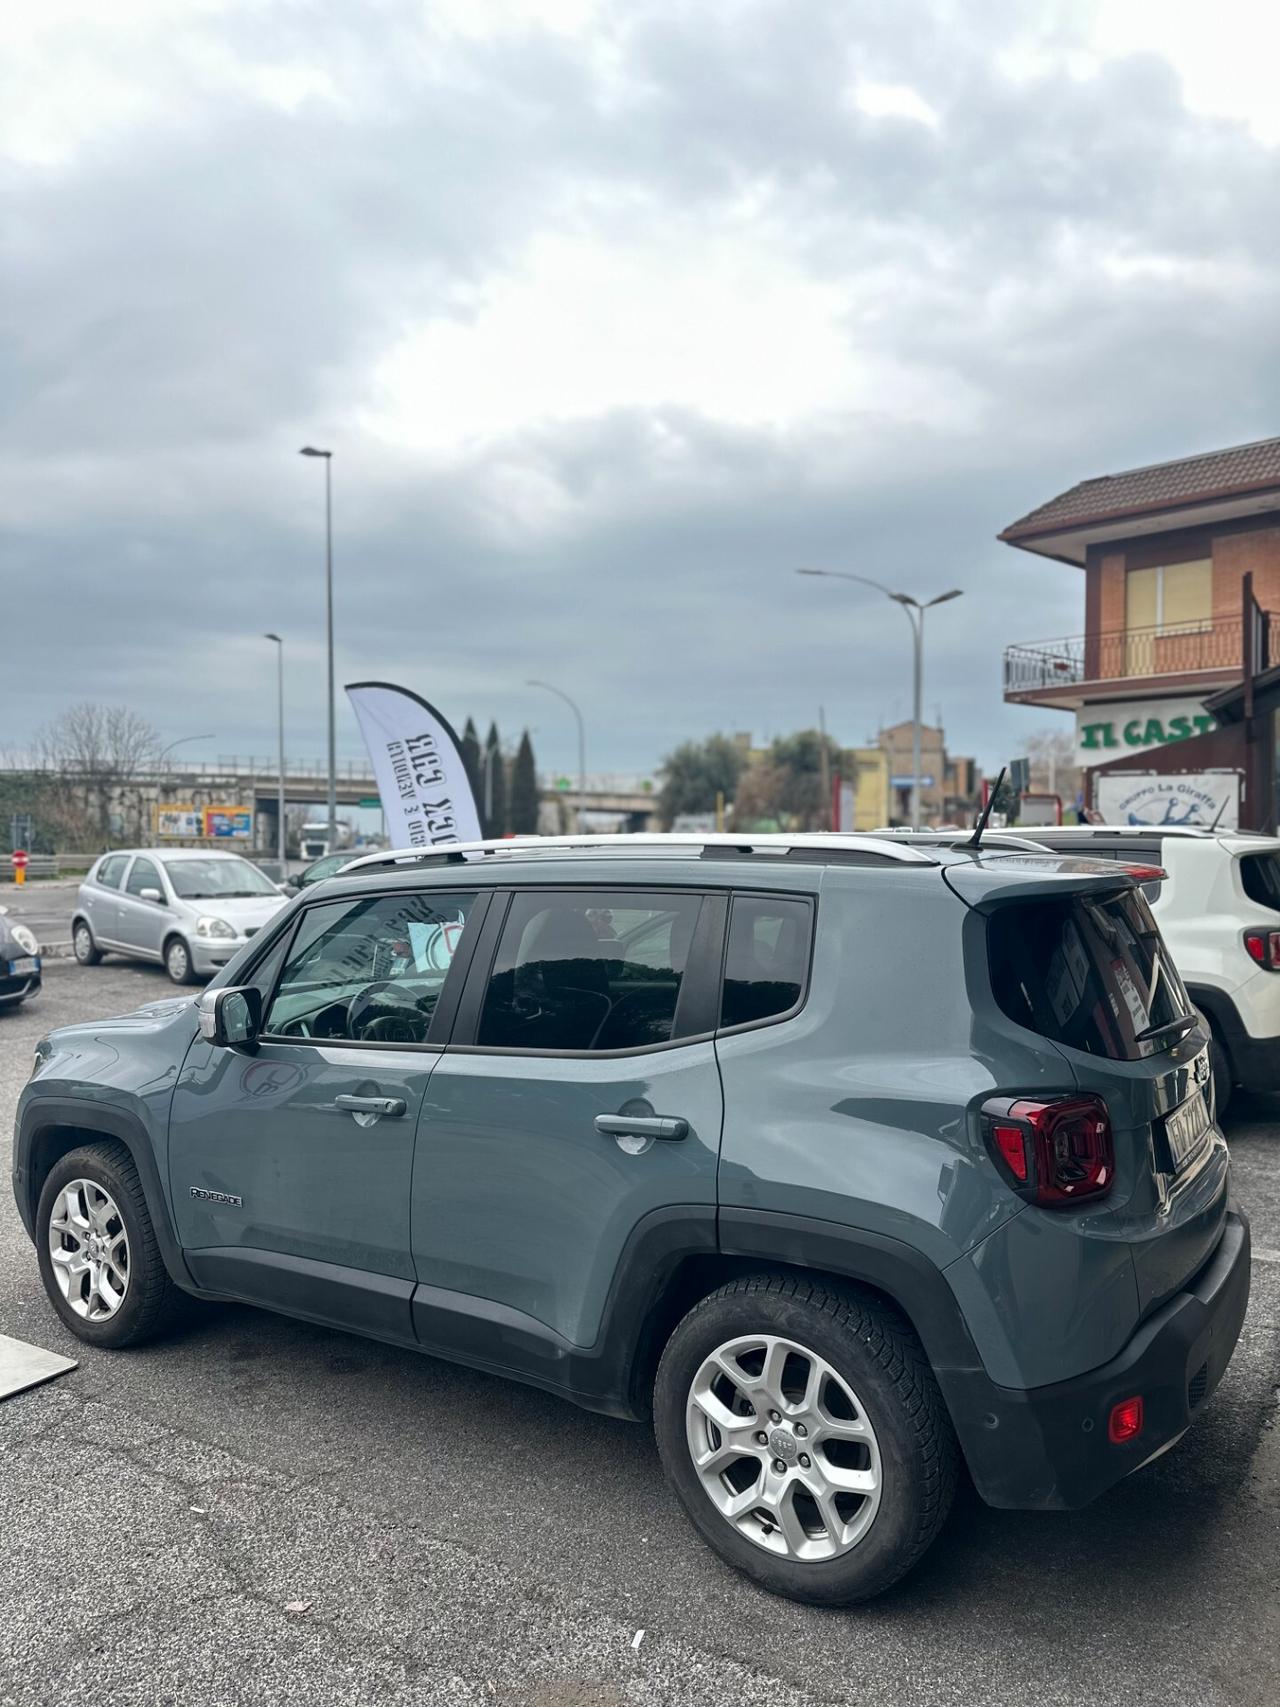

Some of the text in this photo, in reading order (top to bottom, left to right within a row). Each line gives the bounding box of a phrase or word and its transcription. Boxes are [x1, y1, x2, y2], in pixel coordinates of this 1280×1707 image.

[1158, 784, 1173, 792] La
[1177, 784, 1216, 810] Giraffa
[190, 1187, 242, 1207] RENEGADE
